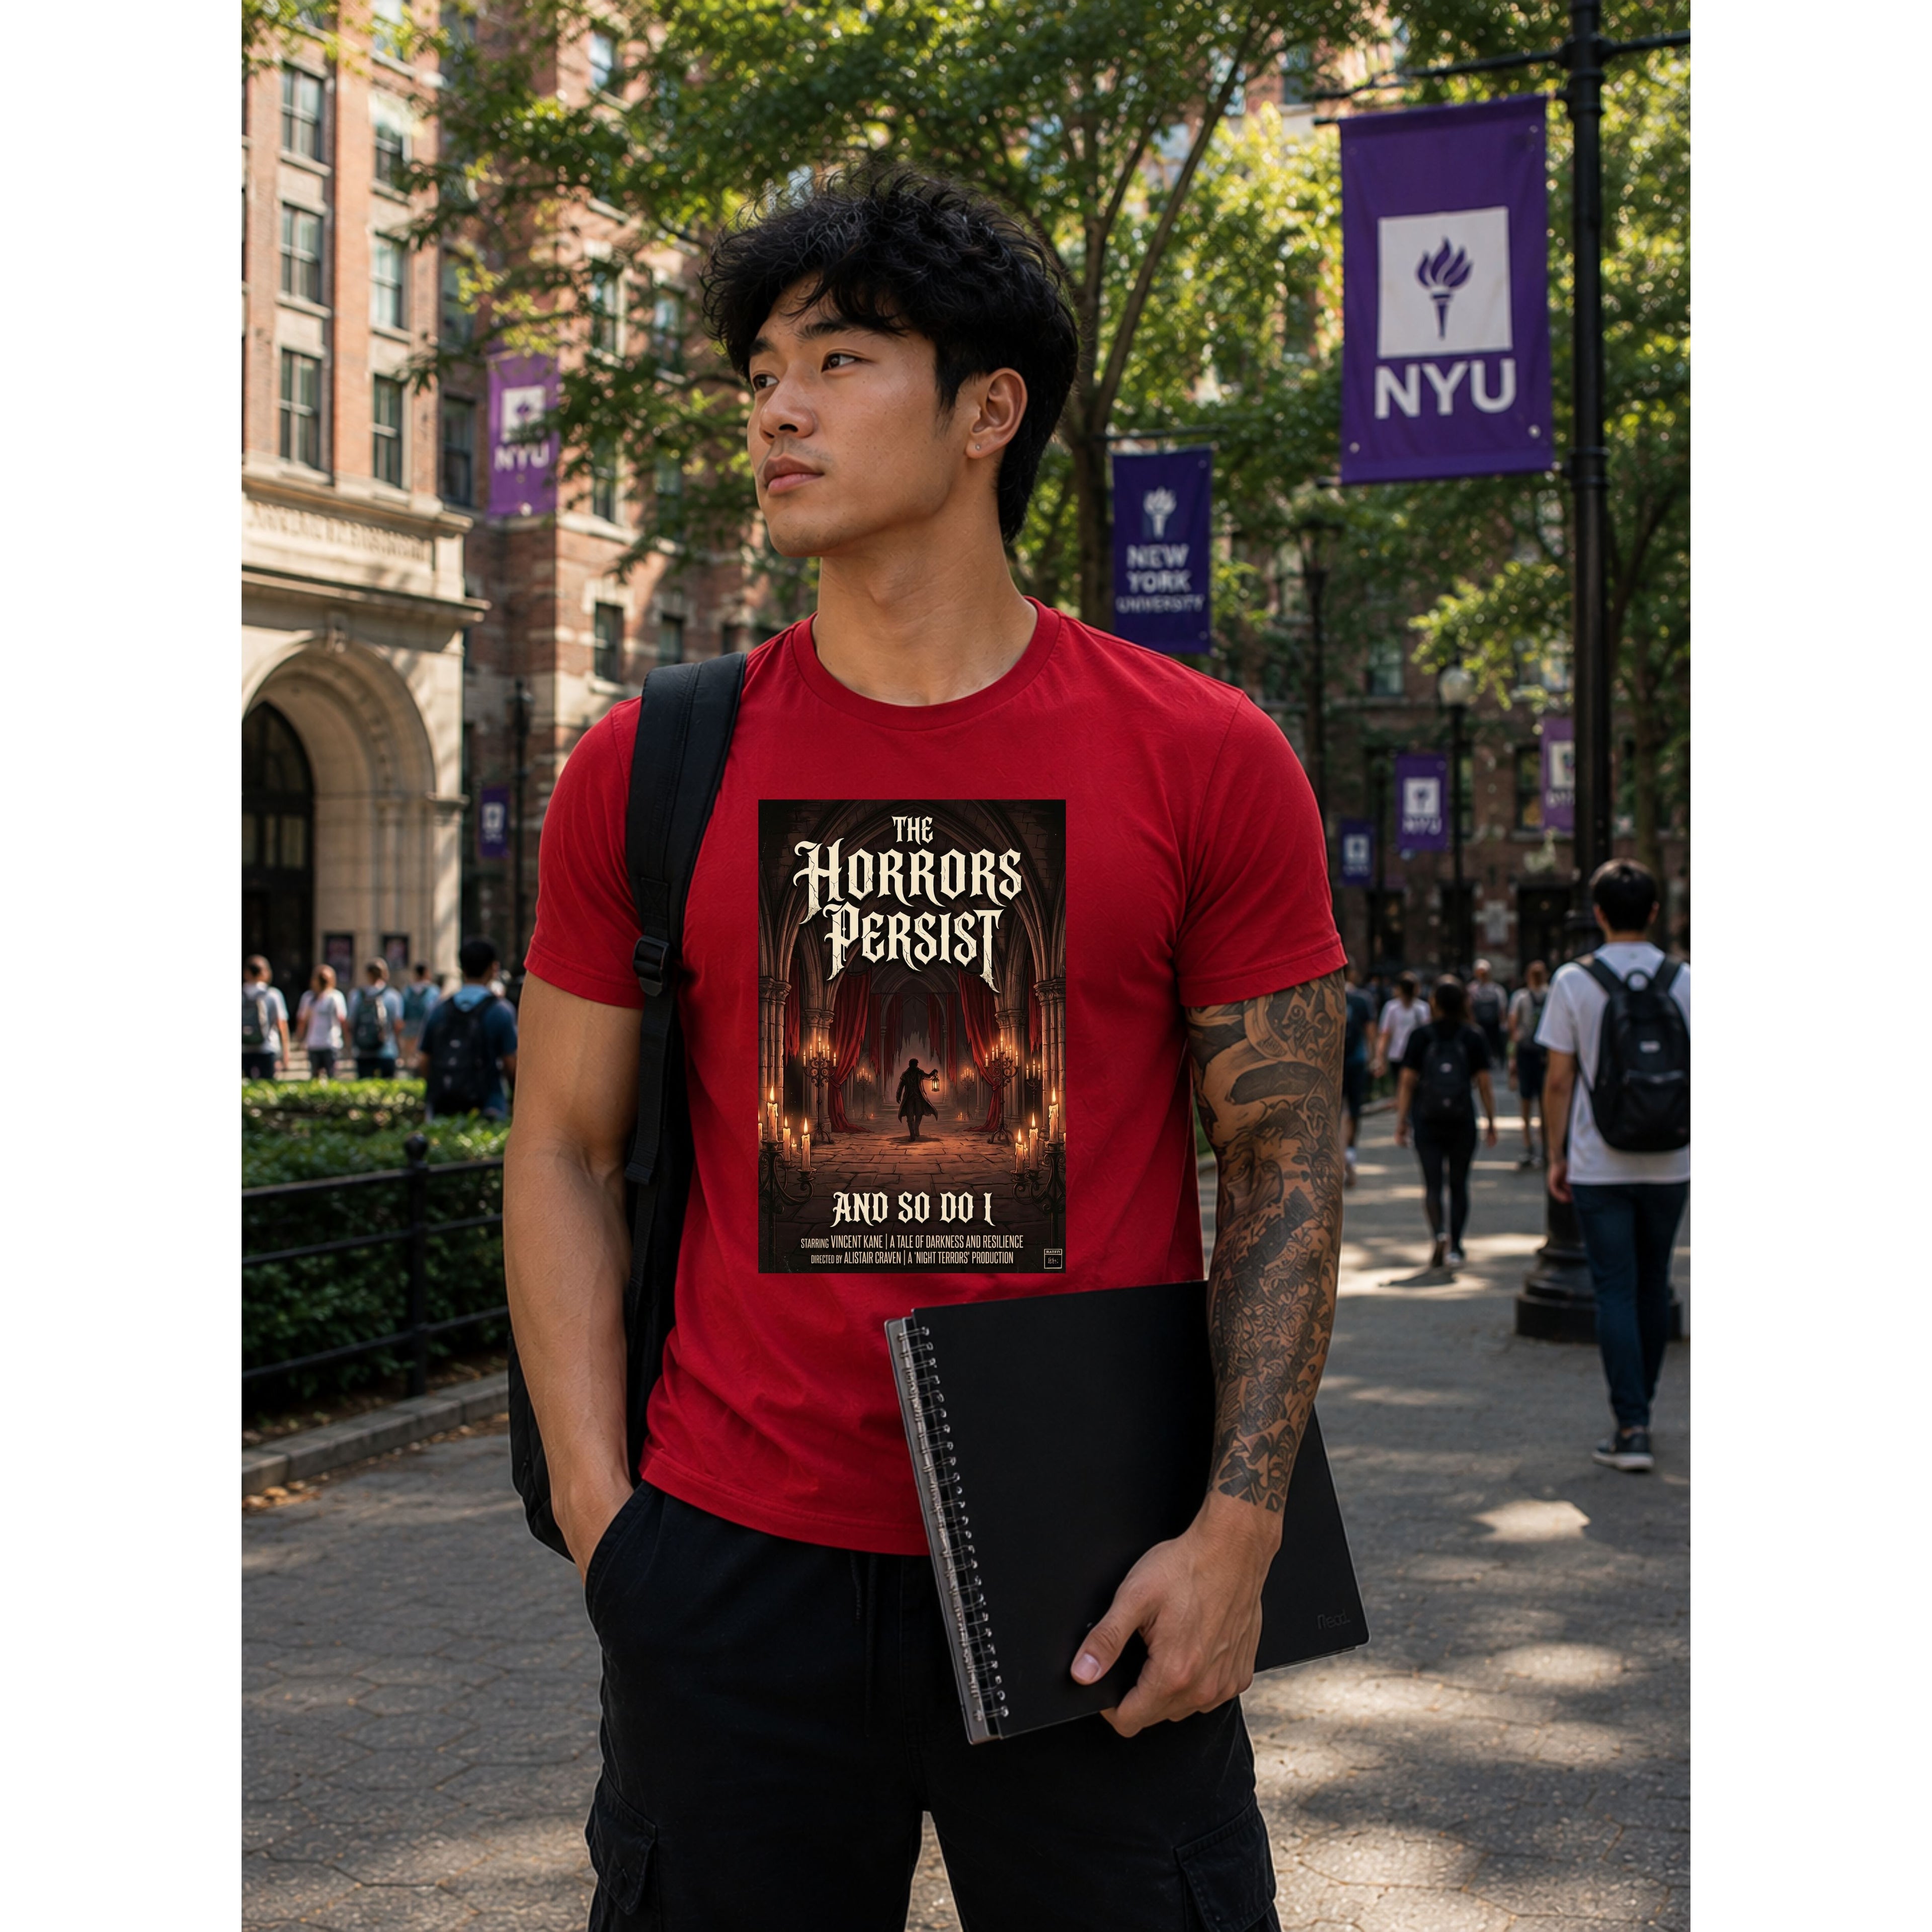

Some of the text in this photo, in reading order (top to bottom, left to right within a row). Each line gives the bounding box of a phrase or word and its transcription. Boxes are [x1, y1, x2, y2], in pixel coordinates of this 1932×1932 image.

[1375, 358, 1516, 420] NYU
[495, 442, 549, 472] NYU
[1127, 544, 1189, 569] NEW
[1126, 570, 1192, 594] YORK
[1115, 594, 1205, 613] UNIVERSITY
[892, 816, 933, 845] THE
[793, 838, 1022, 924] HORRORS
[823, 904, 1004, 993] PERSIST
[830, 1191, 996, 1228] AND SO DO I
[800, 1235, 883, 1248] STARRING VINCENT KANE
[890, 1235, 1024, 1248] A TALE OF DARKNESS AND RESILIENCE
[811, 1251, 901, 1264] DIRECTED BY ALISTAIR CRAVEN
[908, 1251, 1013, 1264] A 'NIGHT TERRORS' PRODUCTION
